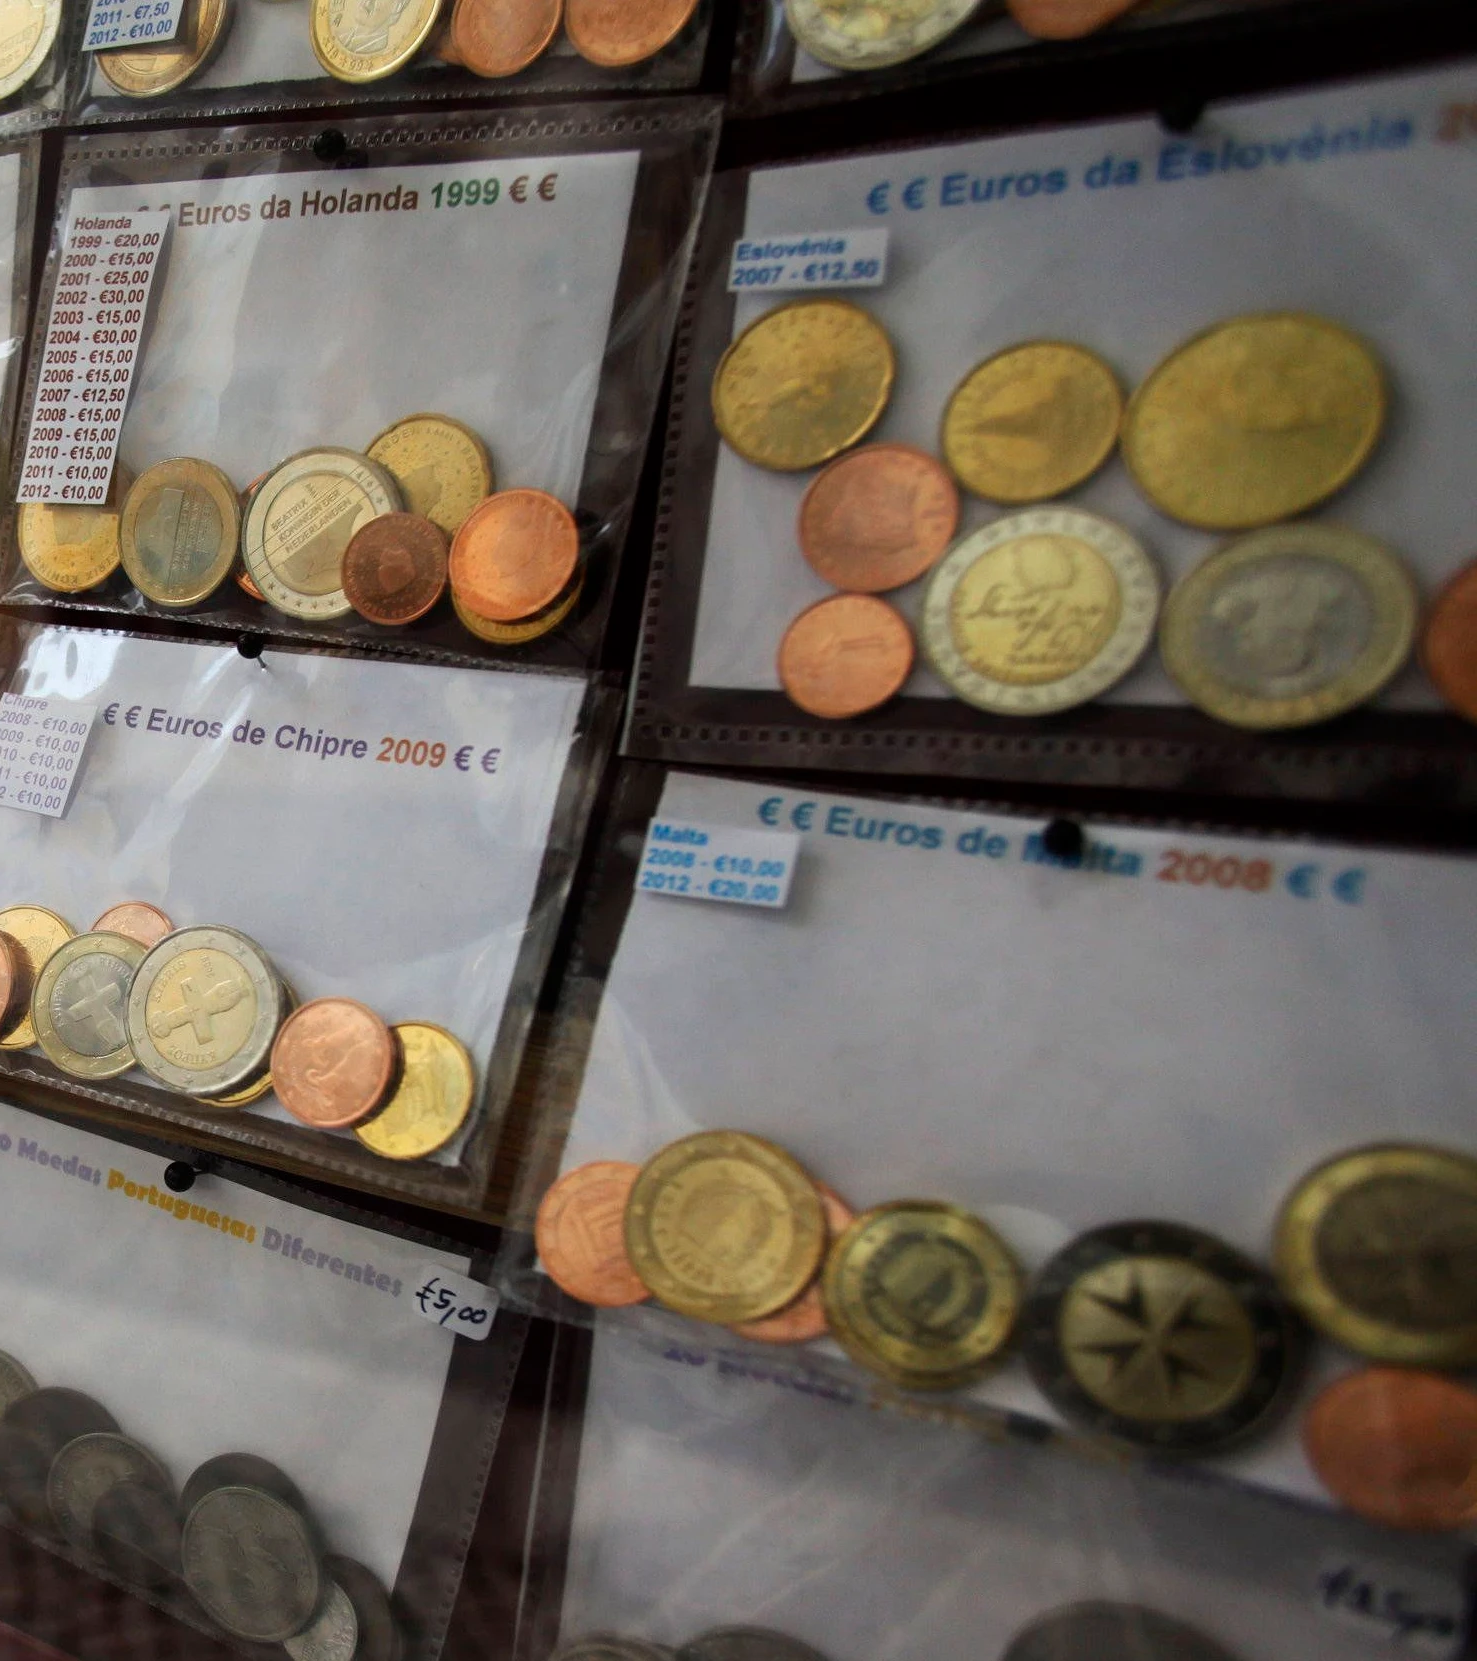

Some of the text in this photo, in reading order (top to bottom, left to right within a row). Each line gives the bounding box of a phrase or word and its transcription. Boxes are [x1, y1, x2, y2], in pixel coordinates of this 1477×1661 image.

[93, 10, 122, 26] 2011
[135, 2, 170, 19] €7,50
[89, 29, 119, 45] 2012
[130, 19, 172, 38] €10,00
[939, 167, 1068, 207] Euros
[1083, 155, 1141, 190] da
[1156, 113, 1412, 182] Eslovénia
[178, 173, 558, 228] Euros da Holanda 1999 € €
[74, 216, 132, 230] Holanda
[70, 235, 102, 248] 1999
[114, 232, 160, 249] €20,00
[736, 238, 846, 261] Eslovénia
[64, 254, 96, 267] 2000
[108, 251, 154, 267] €15,00
[60, 272, 91, 286] 2001
[103, 270, 149, 286] €25,00
[732, 265, 784, 286] 2007
[804, 258, 879, 282] €12,50
[55, 291, 88, 305] 2002
[99, 289, 145, 306] €30,00
[52, 311, 84, 324] 2003
[96, 309, 141, 325] €15,00
[49, 330, 80, 344] 2004
[92, 329, 137, 345] €30,00
[46, 350, 77, 364] 2005
[89, 349, 133, 365] €15,00
[43, 369, 74, 383] 2006
[86, 368, 129, 384] €15,00
[39, 388, 71, 402] 2007
[82, 388, 125, 404] €12,50
[36, 408, 66, 421] 2008
[78, 408, 121, 423] €15,00
[32, 427, 63, 441] 2009
[74, 427, 116, 443] €15,00
[28, 446, 58, 459] 2010
[70, 446, 112, 462] €15,00
[25, 465, 54, 478] 2011
[66, 466, 108, 481] €10,00
[21, 484, 51, 498] 2012
[62, 486, 103, 501] €10,00
[271, 498, 308, 531] BEATRIX
[3, 694, 48, 710] Chipre
[0, 710, 32, 726] 2008
[42, 717, 87, 735] €10,00
[35, 735, 80, 753] €10,00
[103, 702, 501, 775] € € Euros de Chipre 2009 € €
[29, 752, 73, 771] €10,00
[23, 771, 67, 790] €10,00
[17, 790, 62, 810] €10,00
[651, 824, 709, 846] Malta
[758, 797, 783, 826] €
[791, 801, 817, 831] €
[825, 806, 943, 849] Euros
[955, 825, 1008, 859] de
[1155, 849, 1272, 893] 2008
[646, 848, 696, 868] 2008
[713, 854, 785, 878] €10,00
[641, 871, 691, 892] 2012
[708, 878, 779, 901] €20,00
[18, 1137, 102, 1186] Moedas
[107, 1168, 256, 1244] Portuguesas
[262, 1226, 403, 1298] Diferentes
